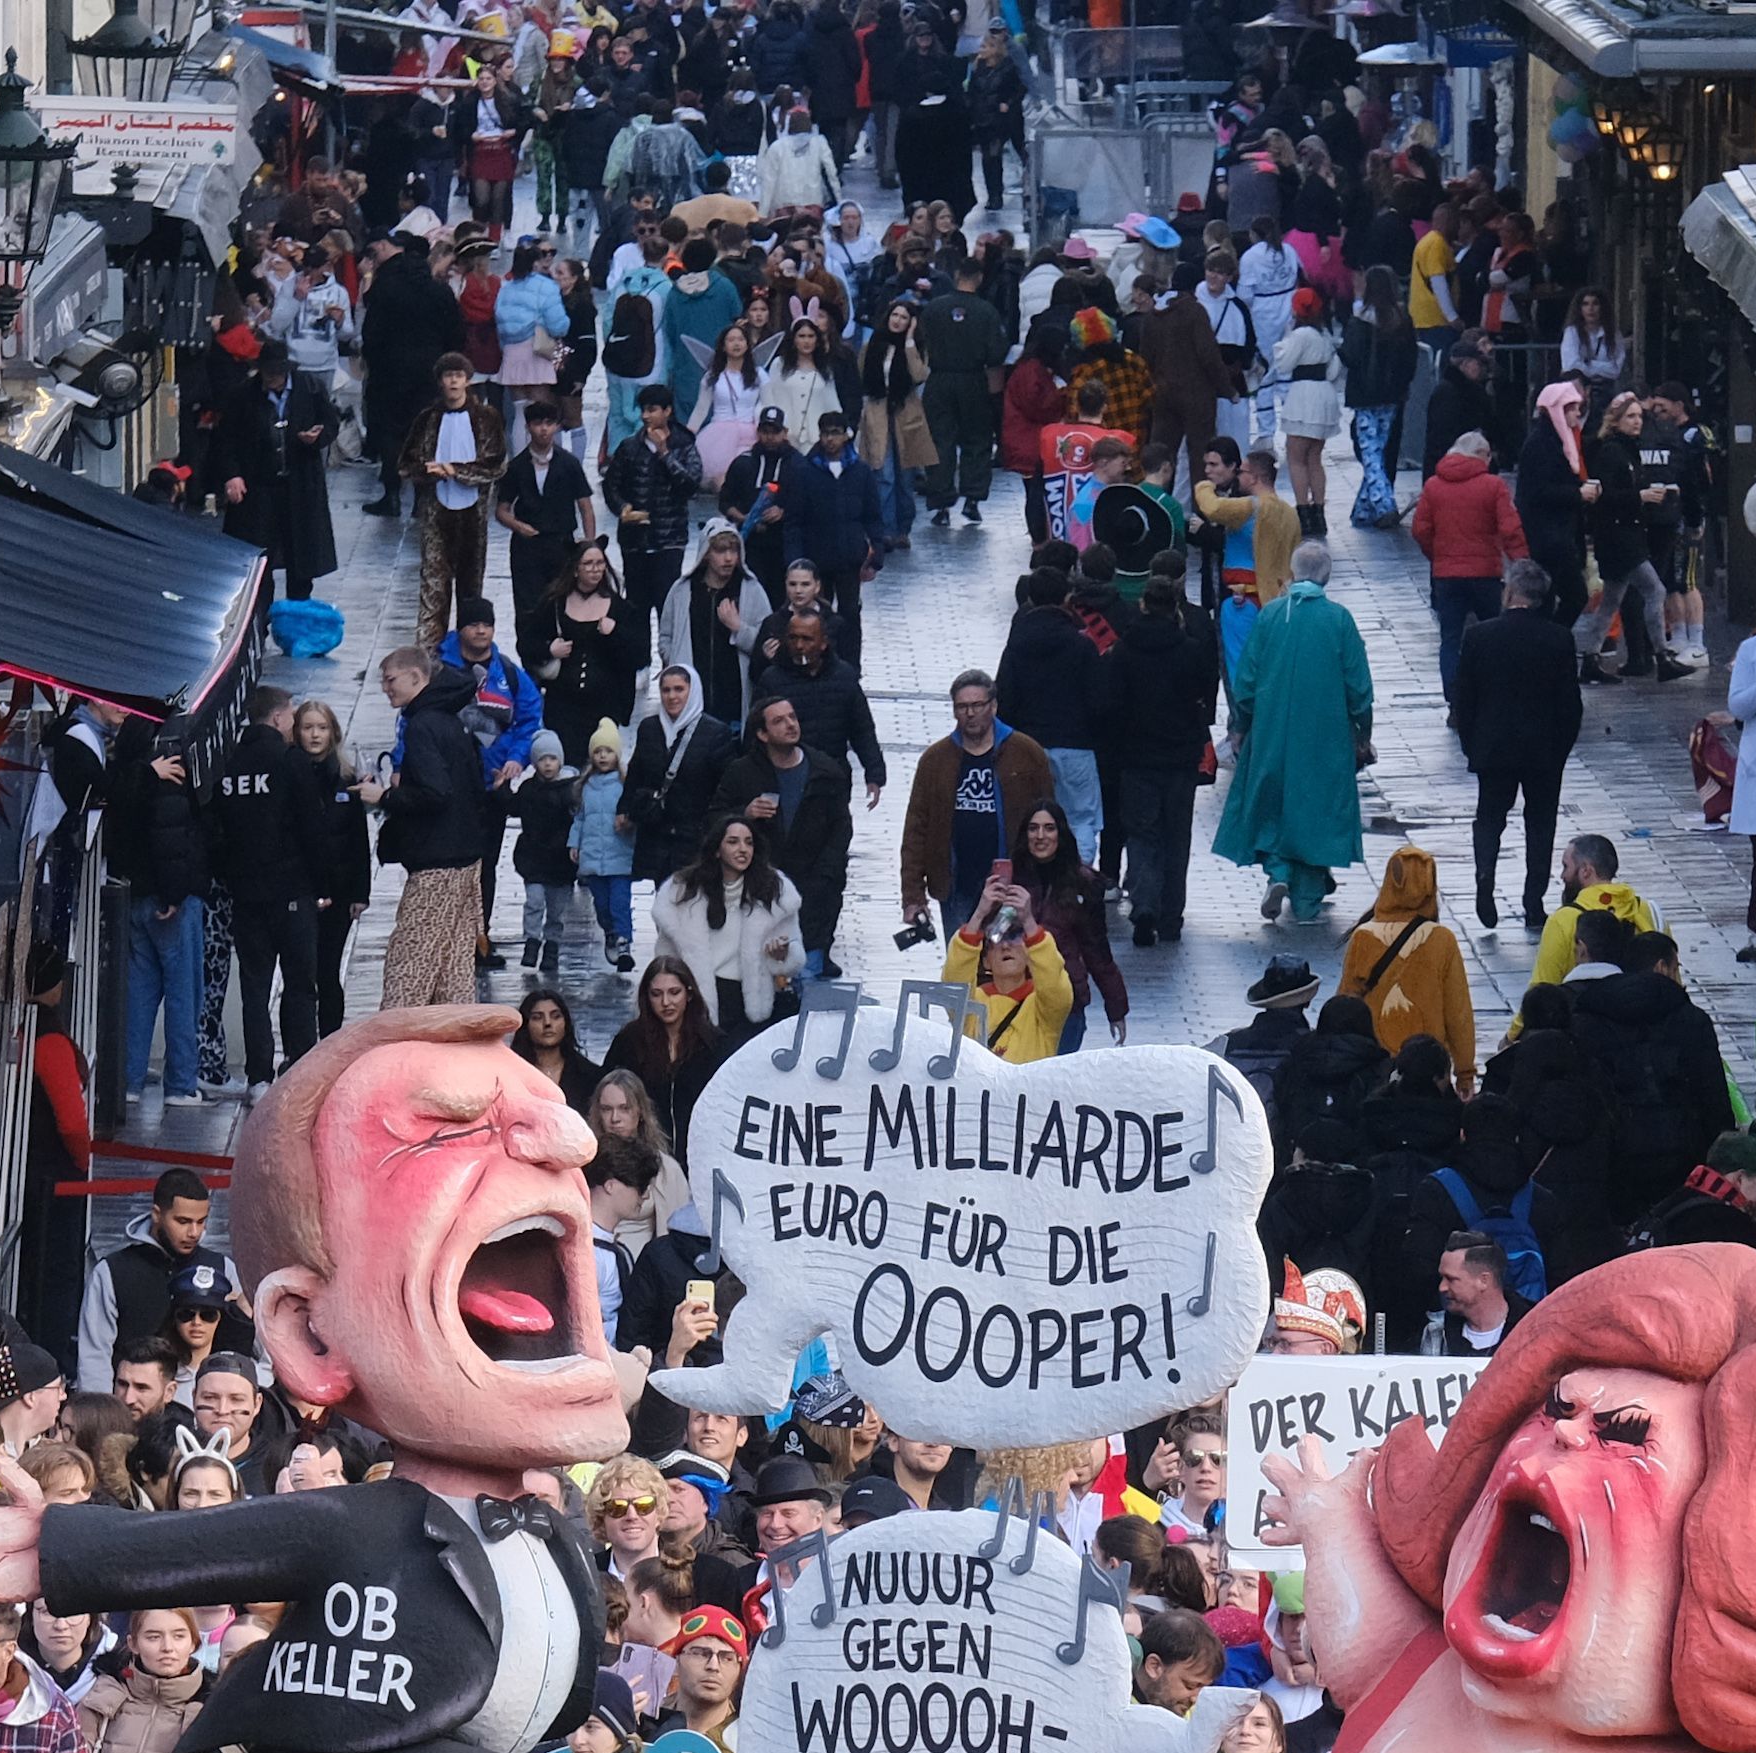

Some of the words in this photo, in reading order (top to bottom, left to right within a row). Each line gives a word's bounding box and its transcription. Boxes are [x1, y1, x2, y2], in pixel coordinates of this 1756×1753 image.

[94, 147, 188, 159] Restaurant
[1639, 449, 1670, 465] WAT
[221, 773, 270, 796] SEK
[734, 1094, 844, 1168] EINE
[863, 1083, 1191, 1194] MILLIARDE
[769, 1182, 889, 1251] EURO
[920, 1196, 1008, 1277] FÜR
[1048, 1220, 1130, 1287] DIE
[852, 1262, 1183, 1390] OOOPER!
[1249, 1391, 1336, 1454] DER
[323, 1581, 398, 1642] OB
[840, 1550, 998, 1616] NUUUR
[262, 1640, 416, 1712] KELLER
[842, 1617, 993, 1680] GEGEN
